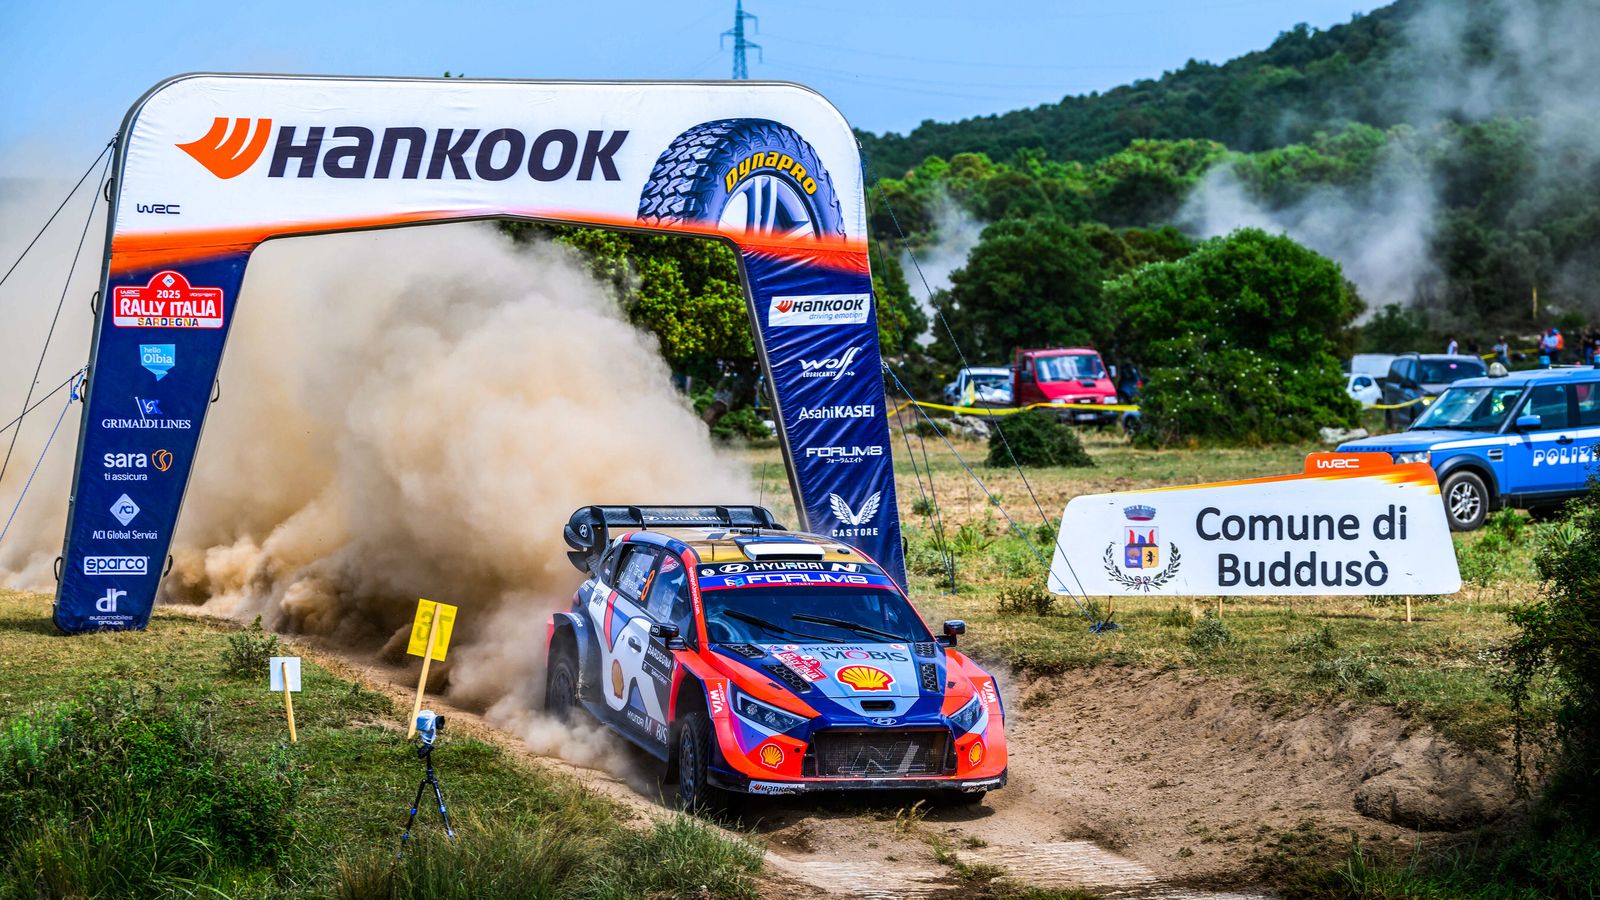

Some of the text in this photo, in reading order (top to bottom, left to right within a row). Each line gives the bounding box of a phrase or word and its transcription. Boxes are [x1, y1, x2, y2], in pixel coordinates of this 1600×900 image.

[136, 203, 180, 214] WRC
[156, 289, 181, 299] 2025
[120, 298, 217, 317] RALLY ITALIA
[137, 317, 200, 327] SARDEGNA
[144, 346, 162, 354] hello
[143, 353, 173, 364] Olbia
[102, 418, 191, 429] GRIMALDI LINES
[806, 446, 883, 457] FORUM8
[103, 453, 148, 468] sara
[1316, 458, 1360, 468] WRC
[104, 473, 148, 481] ti assicura
[1195, 504, 1407, 541] Comune di
[92, 530, 158, 540] ACI Global Servizi
[832, 528, 878, 537] CASTORE
[86, 558, 145, 574] sparco
[753, 562, 825, 570] HYUNDAI
[1217, 550, 1389, 587] Buddusò
[95, 588, 127, 612] dr
[820, 650, 909, 662] MOBIS
